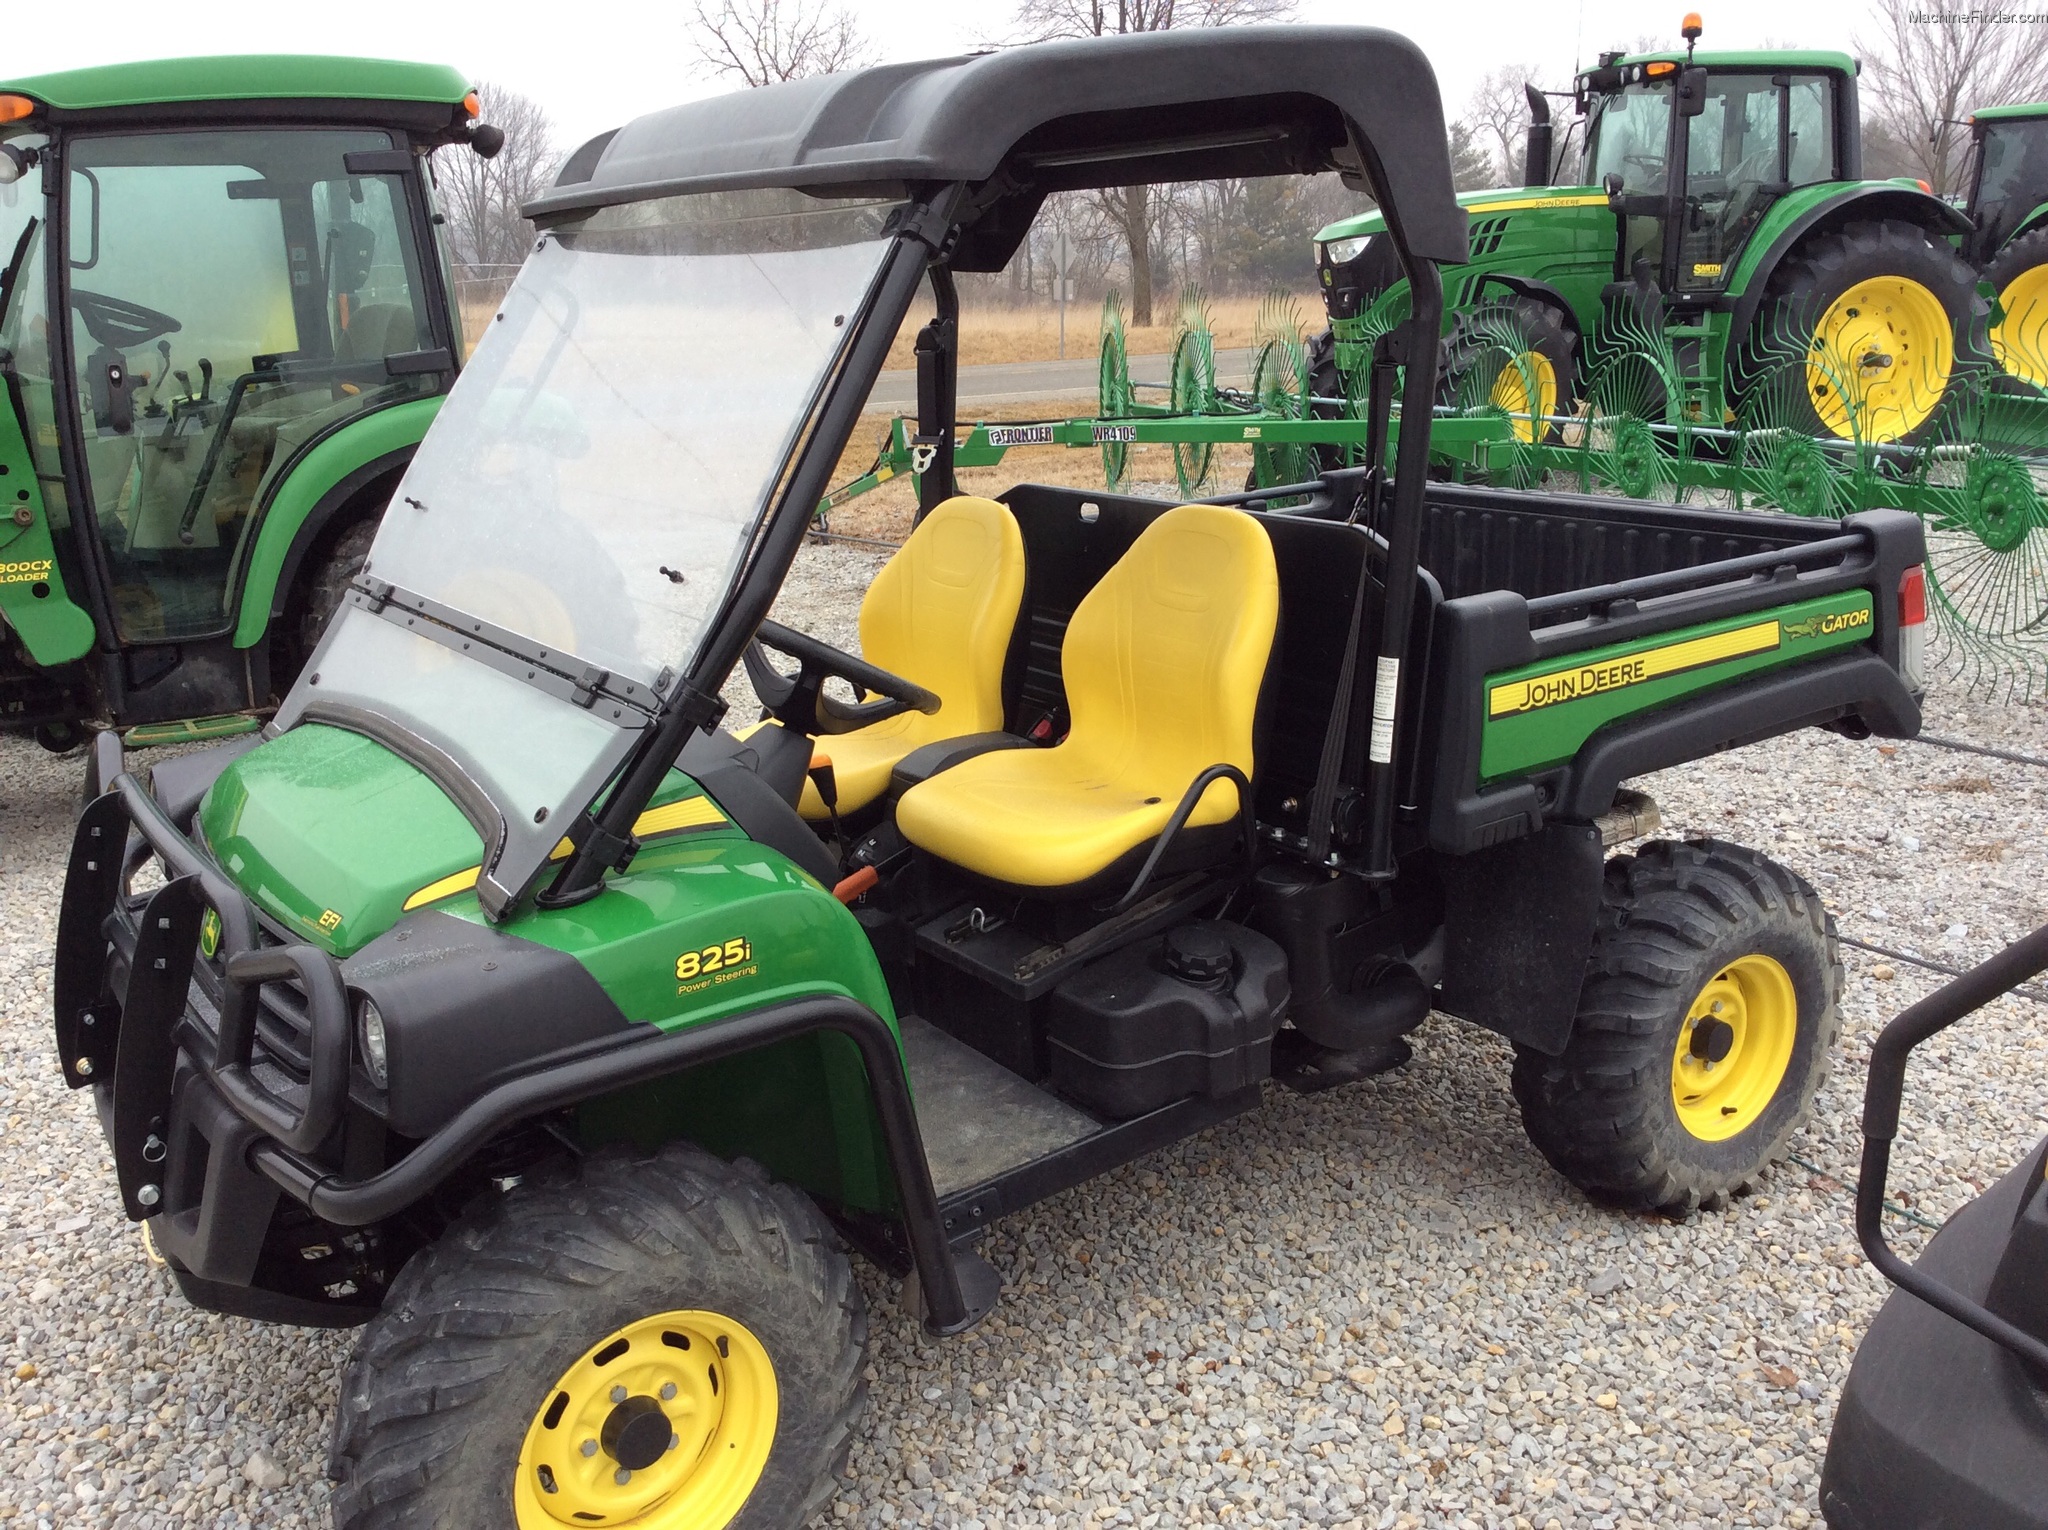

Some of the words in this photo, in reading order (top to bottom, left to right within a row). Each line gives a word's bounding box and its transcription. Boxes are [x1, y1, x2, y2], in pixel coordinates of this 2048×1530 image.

[1533, 200, 1554, 208] JOHN
[1693, 264, 1721, 274] SMITH
[1001, 427, 1052, 443] FRONTIER
[1093, 426, 1136, 440] WR4109
[0, 572, 48, 583] LOADER
[1821, 609, 1870, 634] GATOR
[1519, 677, 1575, 708] JOHN
[1581, 659, 1645, 692] DEERE
[319, 909, 342, 930] EFI
[676, 937, 751, 979] 825i
[678, 979, 712, 995] Power
[714, 964, 758, 985] Steering
